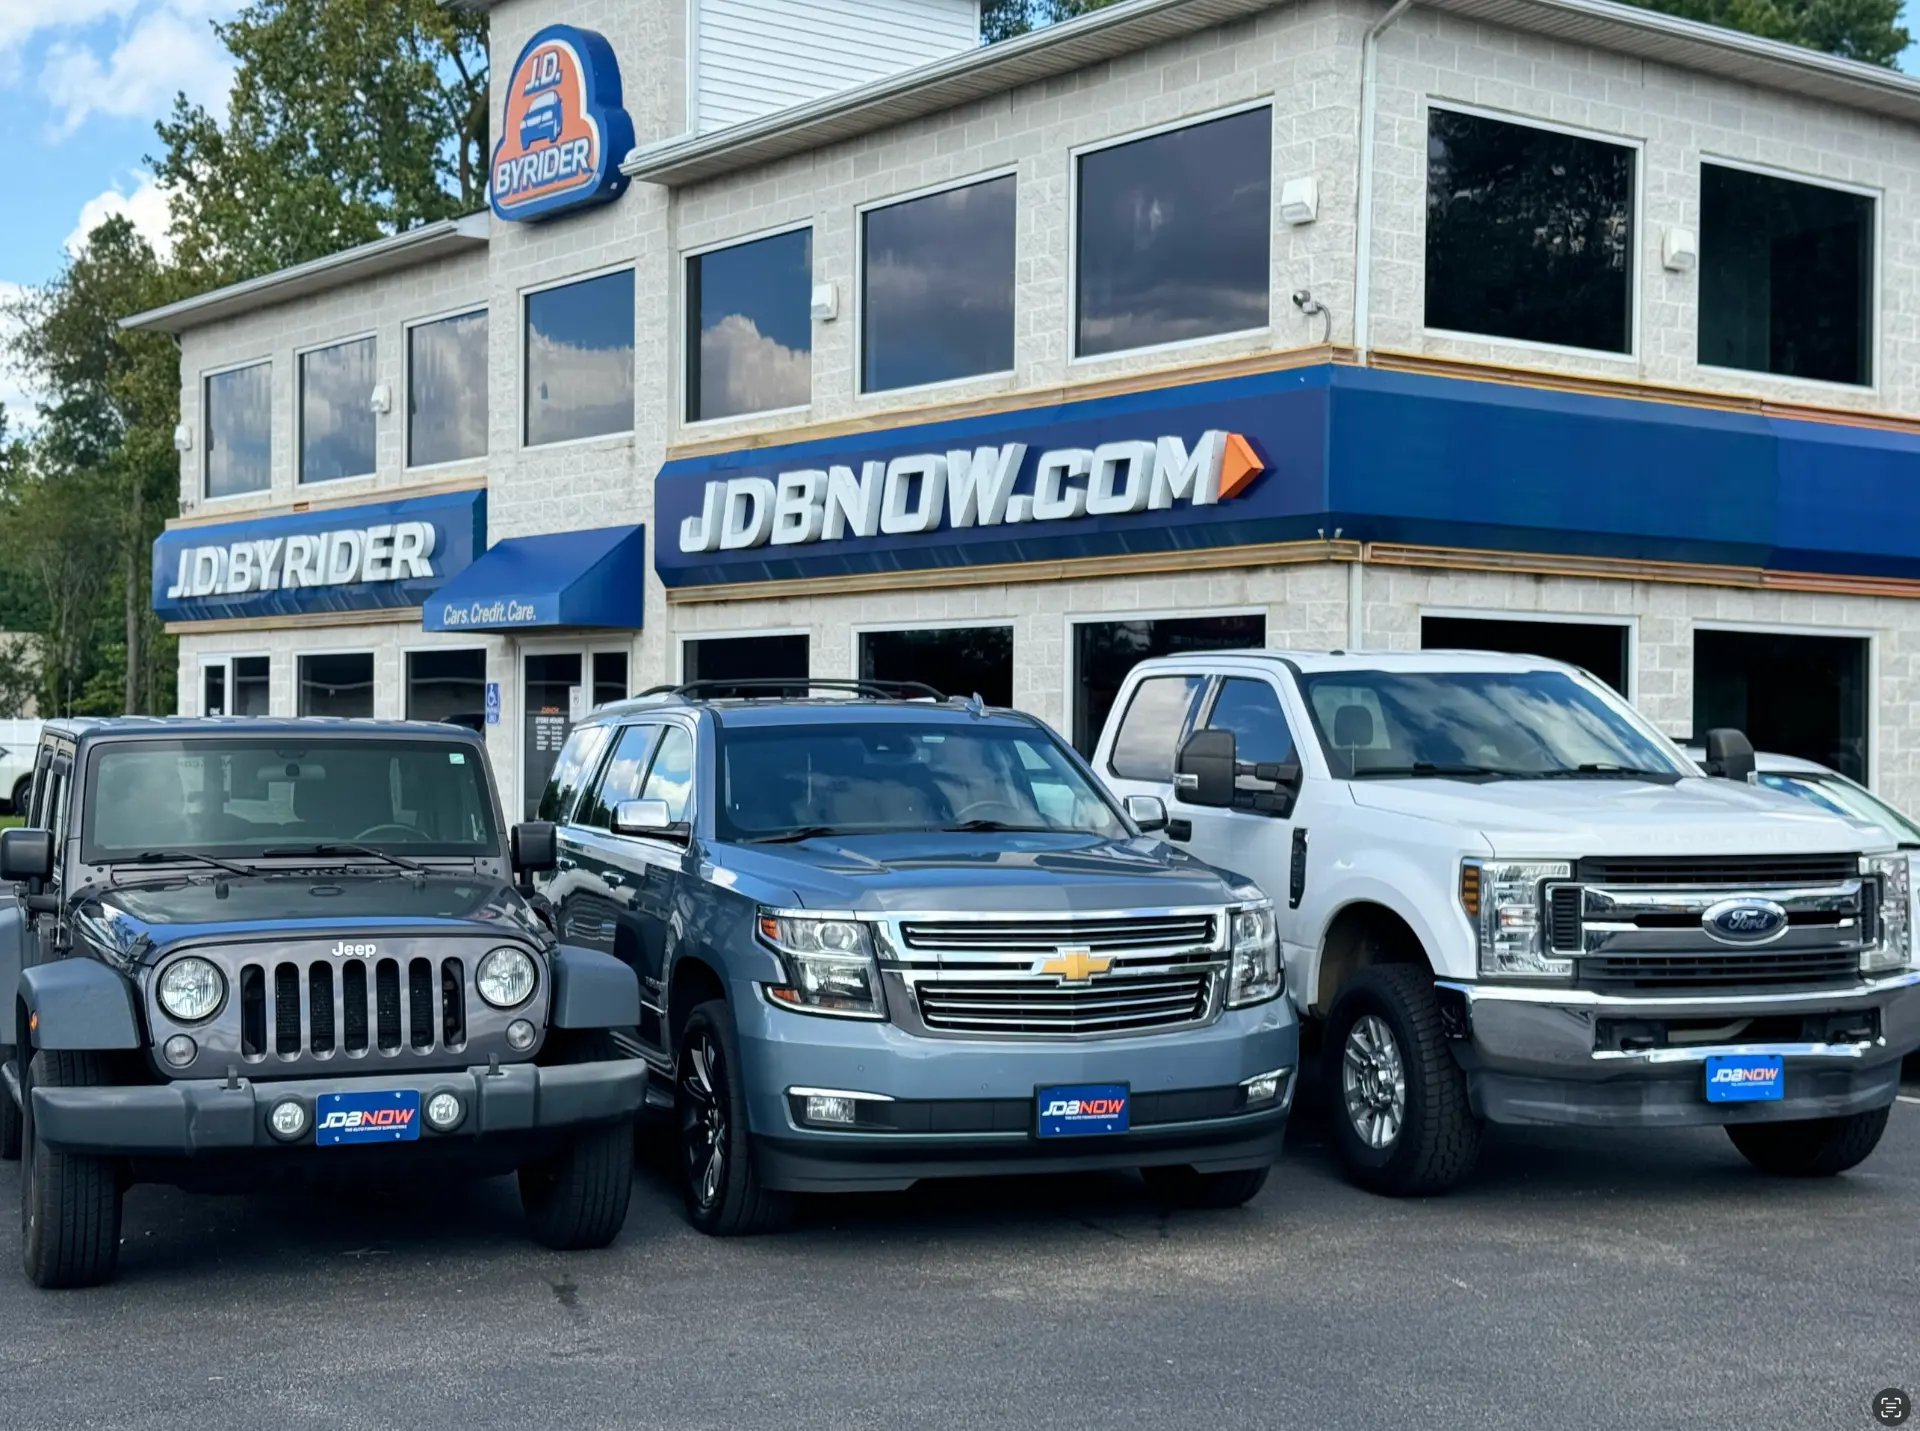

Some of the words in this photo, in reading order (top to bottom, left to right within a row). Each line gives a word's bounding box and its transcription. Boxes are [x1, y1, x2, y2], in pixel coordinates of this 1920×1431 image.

[523, 50, 562, 94] J.D.
[495, 136, 593, 197] BYRIDER
[679, 429, 1228, 553] JDBNOW.COM
[1728, 909, 1768, 930] Ford
[331, 941, 377, 958] Jeep
[1041, 1098, 1125, 1116] JDBNOW
[318, 1108, 415, 1129] JDBNOW
